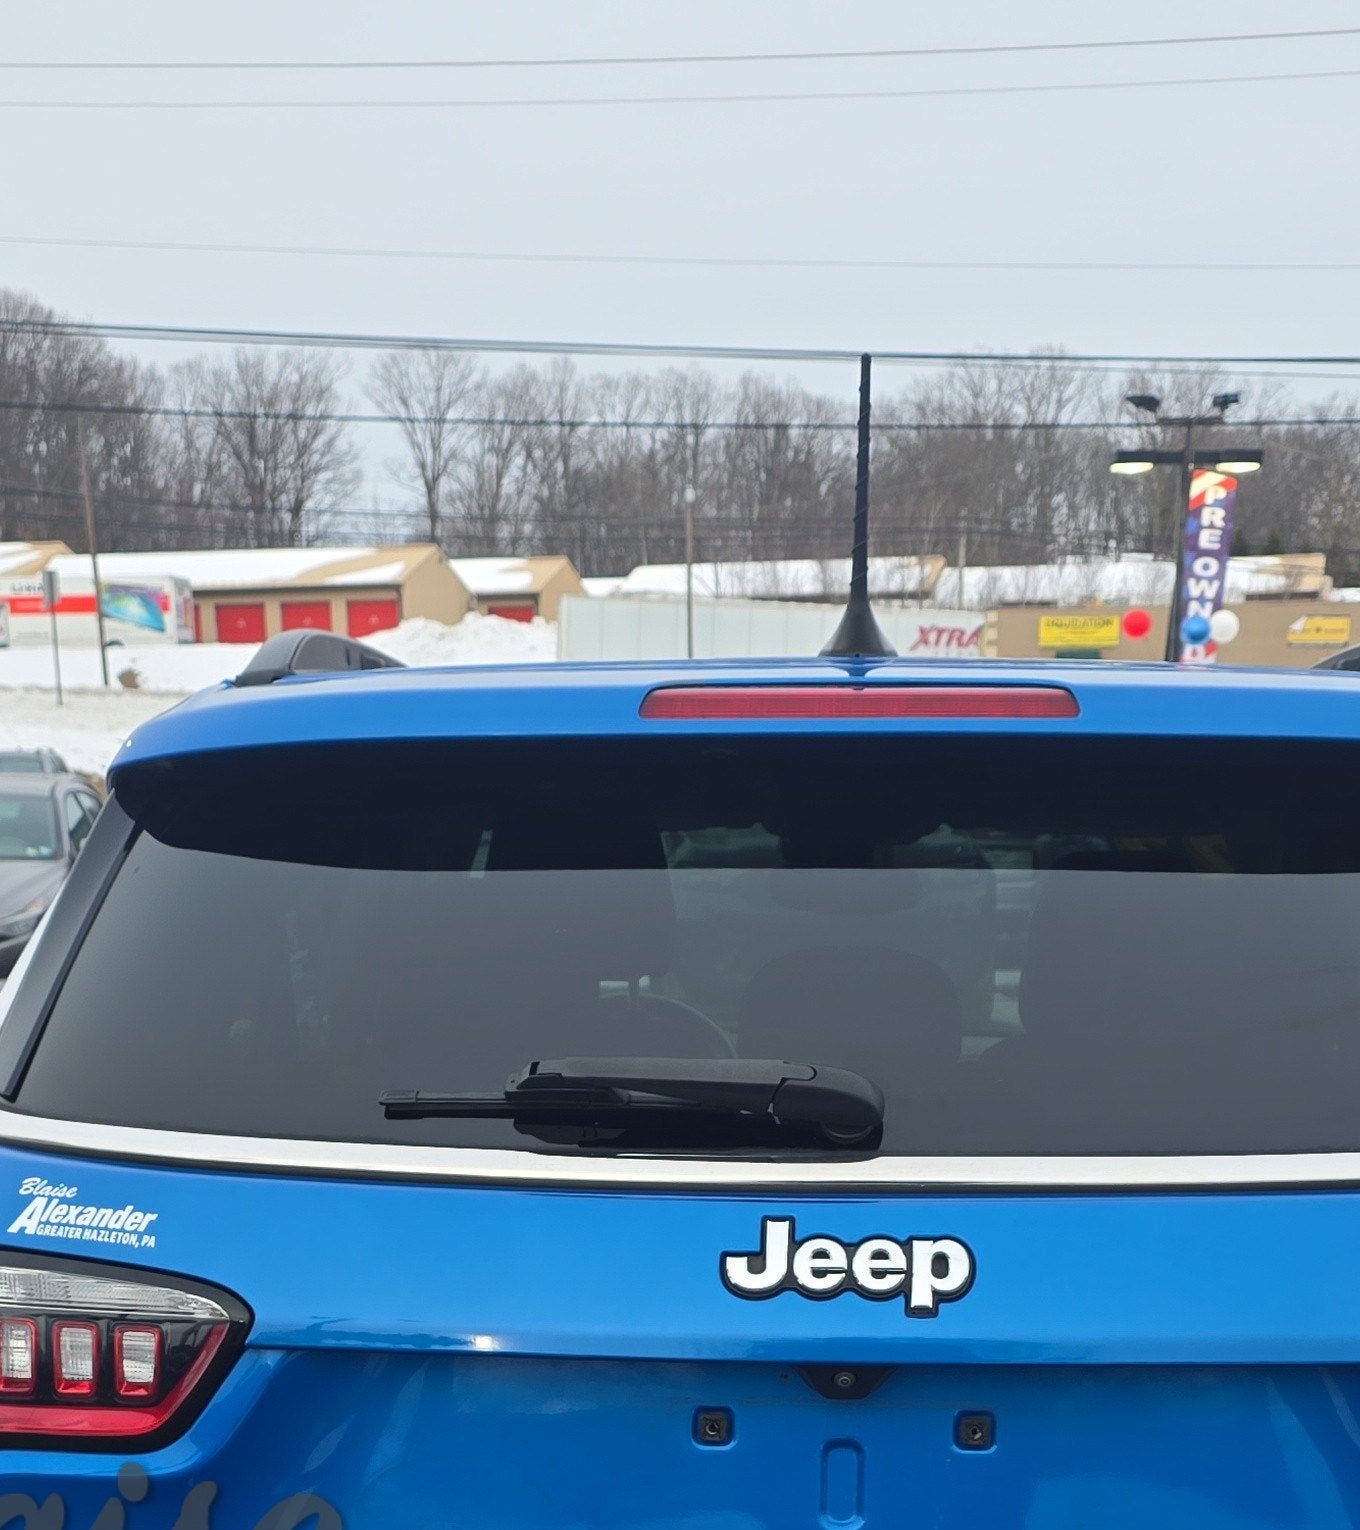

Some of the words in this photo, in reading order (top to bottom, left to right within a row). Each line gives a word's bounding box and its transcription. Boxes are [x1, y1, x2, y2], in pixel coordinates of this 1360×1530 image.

[1197, 485, 1228, 551] PRE
[1181, 555, 1221, 661] OWND
[910, 624, 981, 651] XTRA
[18, 1176, 78, 1198] Blaise
[7, 1196, 159, 1235] Alexander
[36, 1225, 83, 1240] GREATER
[83, 1228, 139, 1248] HAZLETON,
[141, 1235, 156, 1248] PA
[722, 1216, 975, 1316] Jeep
